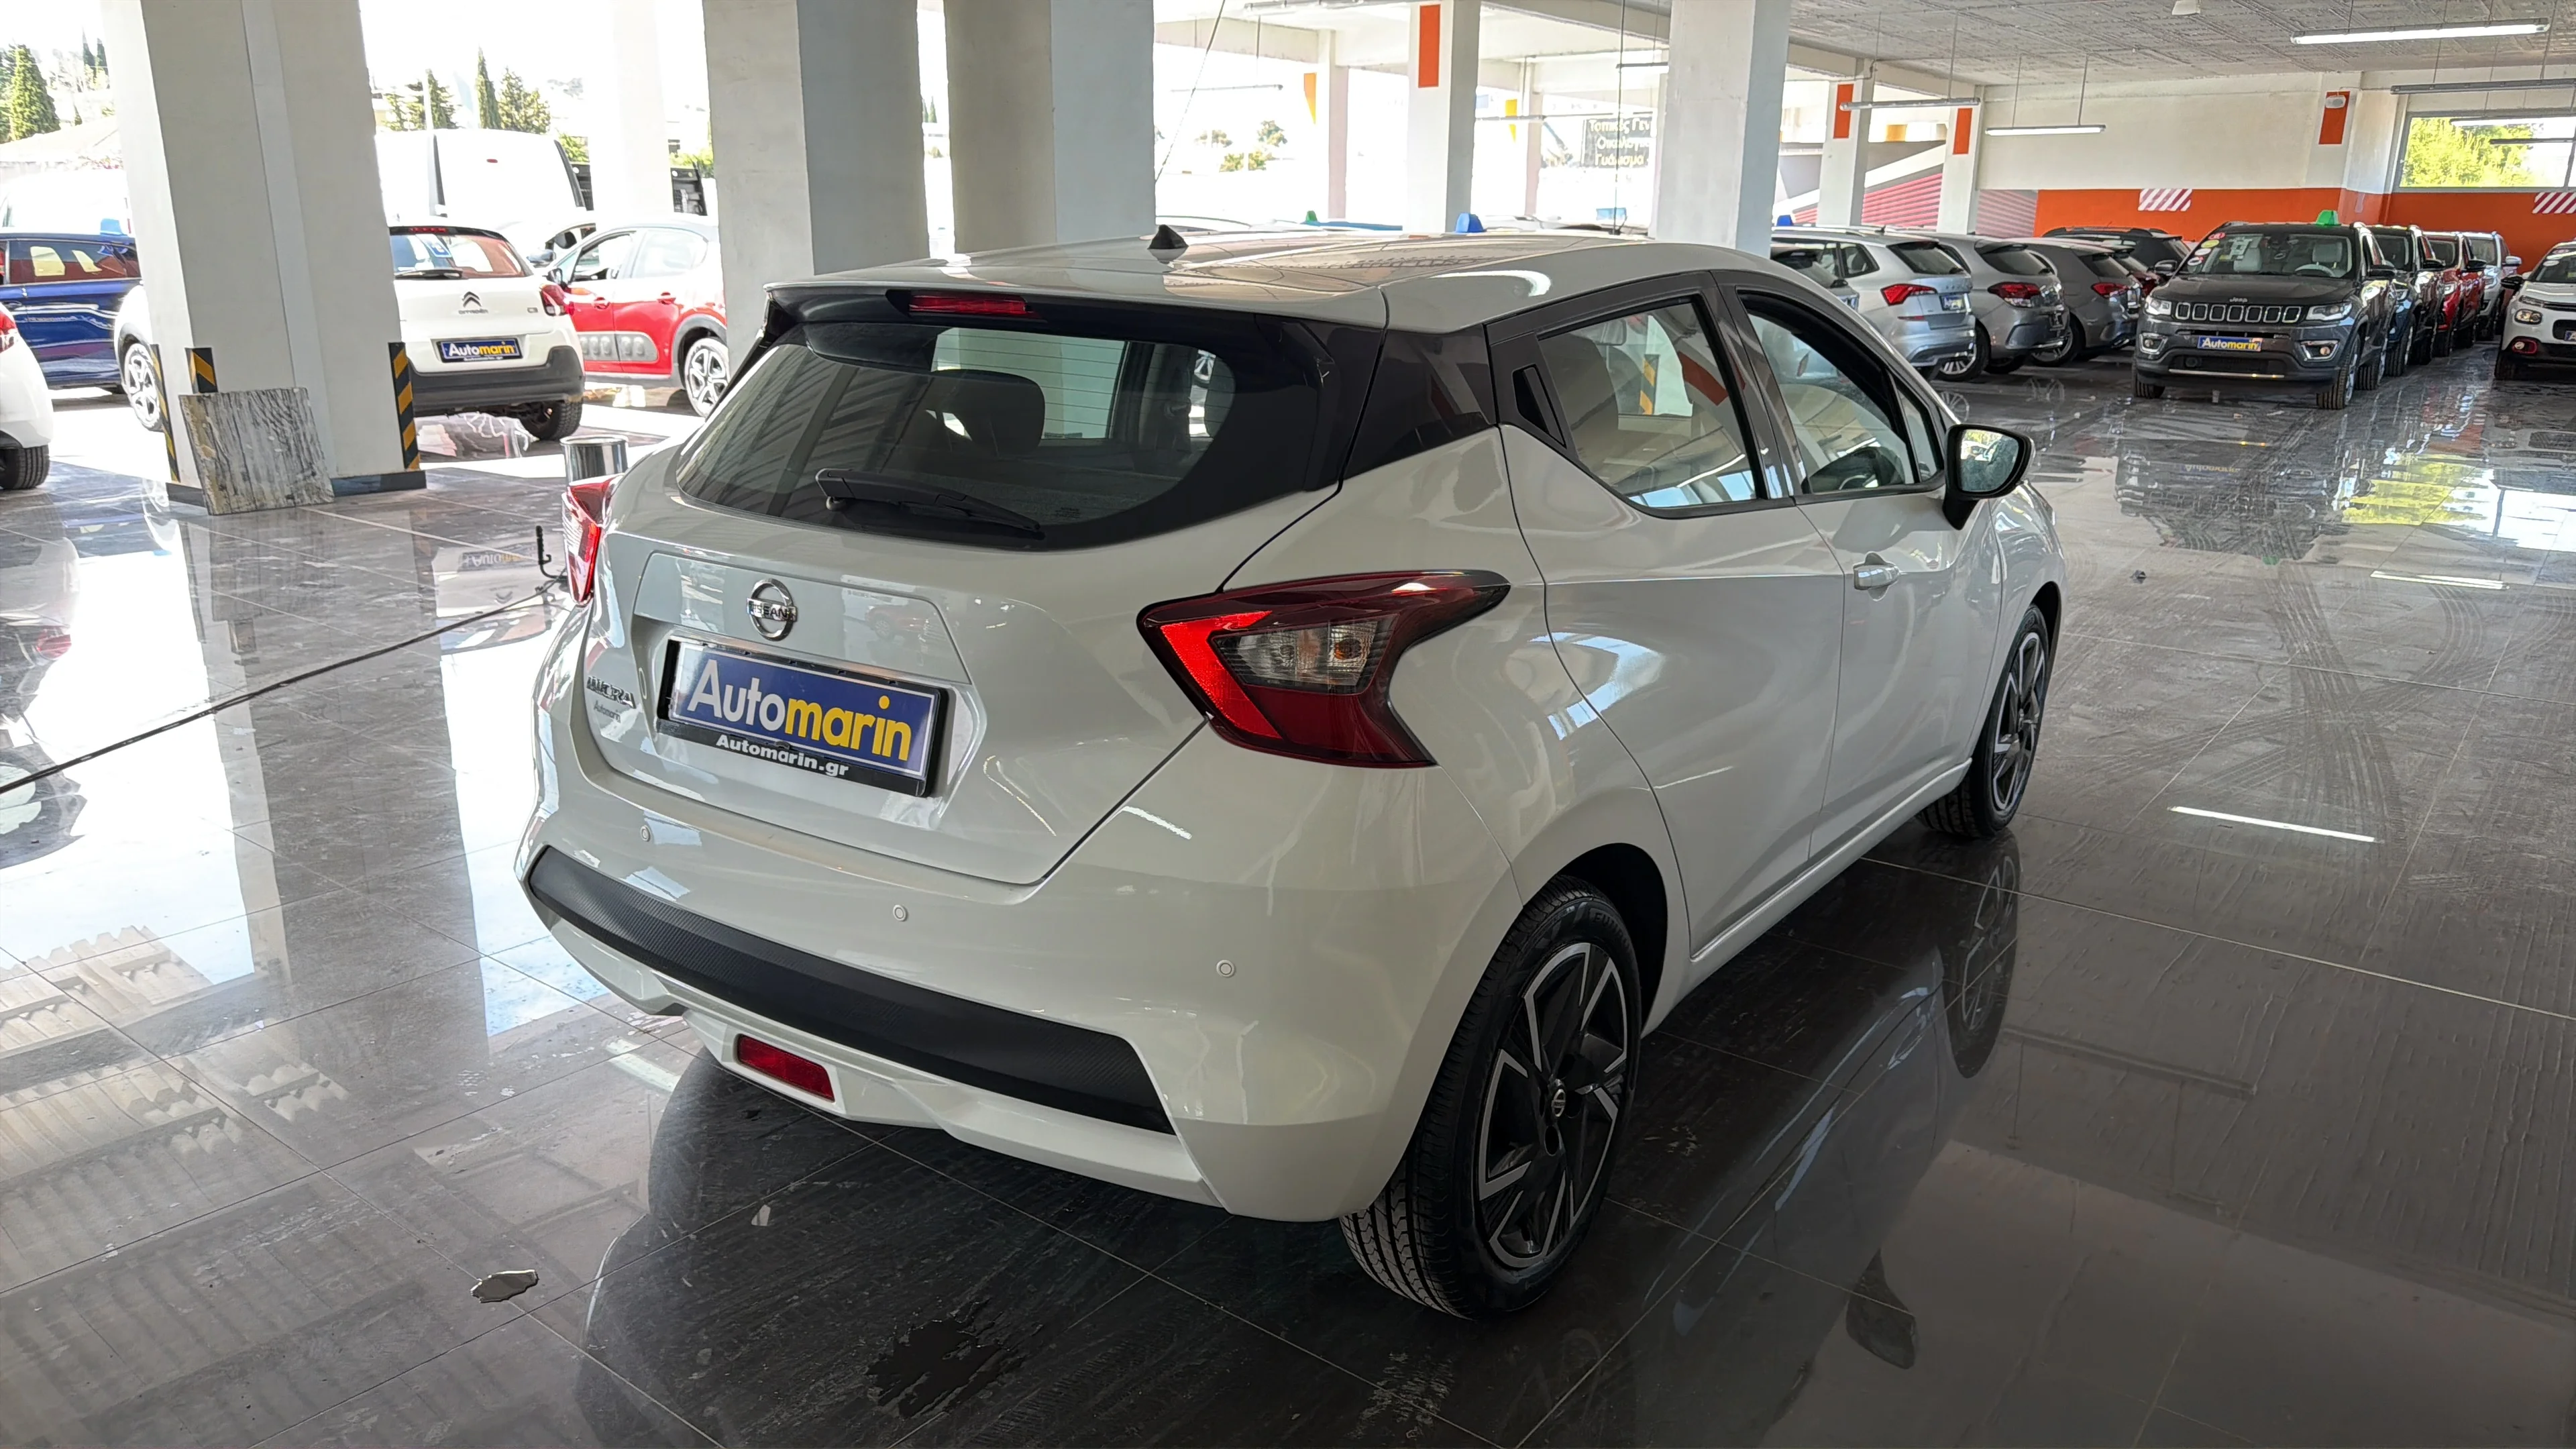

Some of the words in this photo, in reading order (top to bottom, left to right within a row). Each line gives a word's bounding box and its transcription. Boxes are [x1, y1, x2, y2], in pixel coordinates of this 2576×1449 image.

[449, 341, 515, 356] Automarin
[2201, 337, 2258, 350] Automarin
[687, 659, 912, 761] Automarin
[716, 734, 849, 777] Automarin.gr
